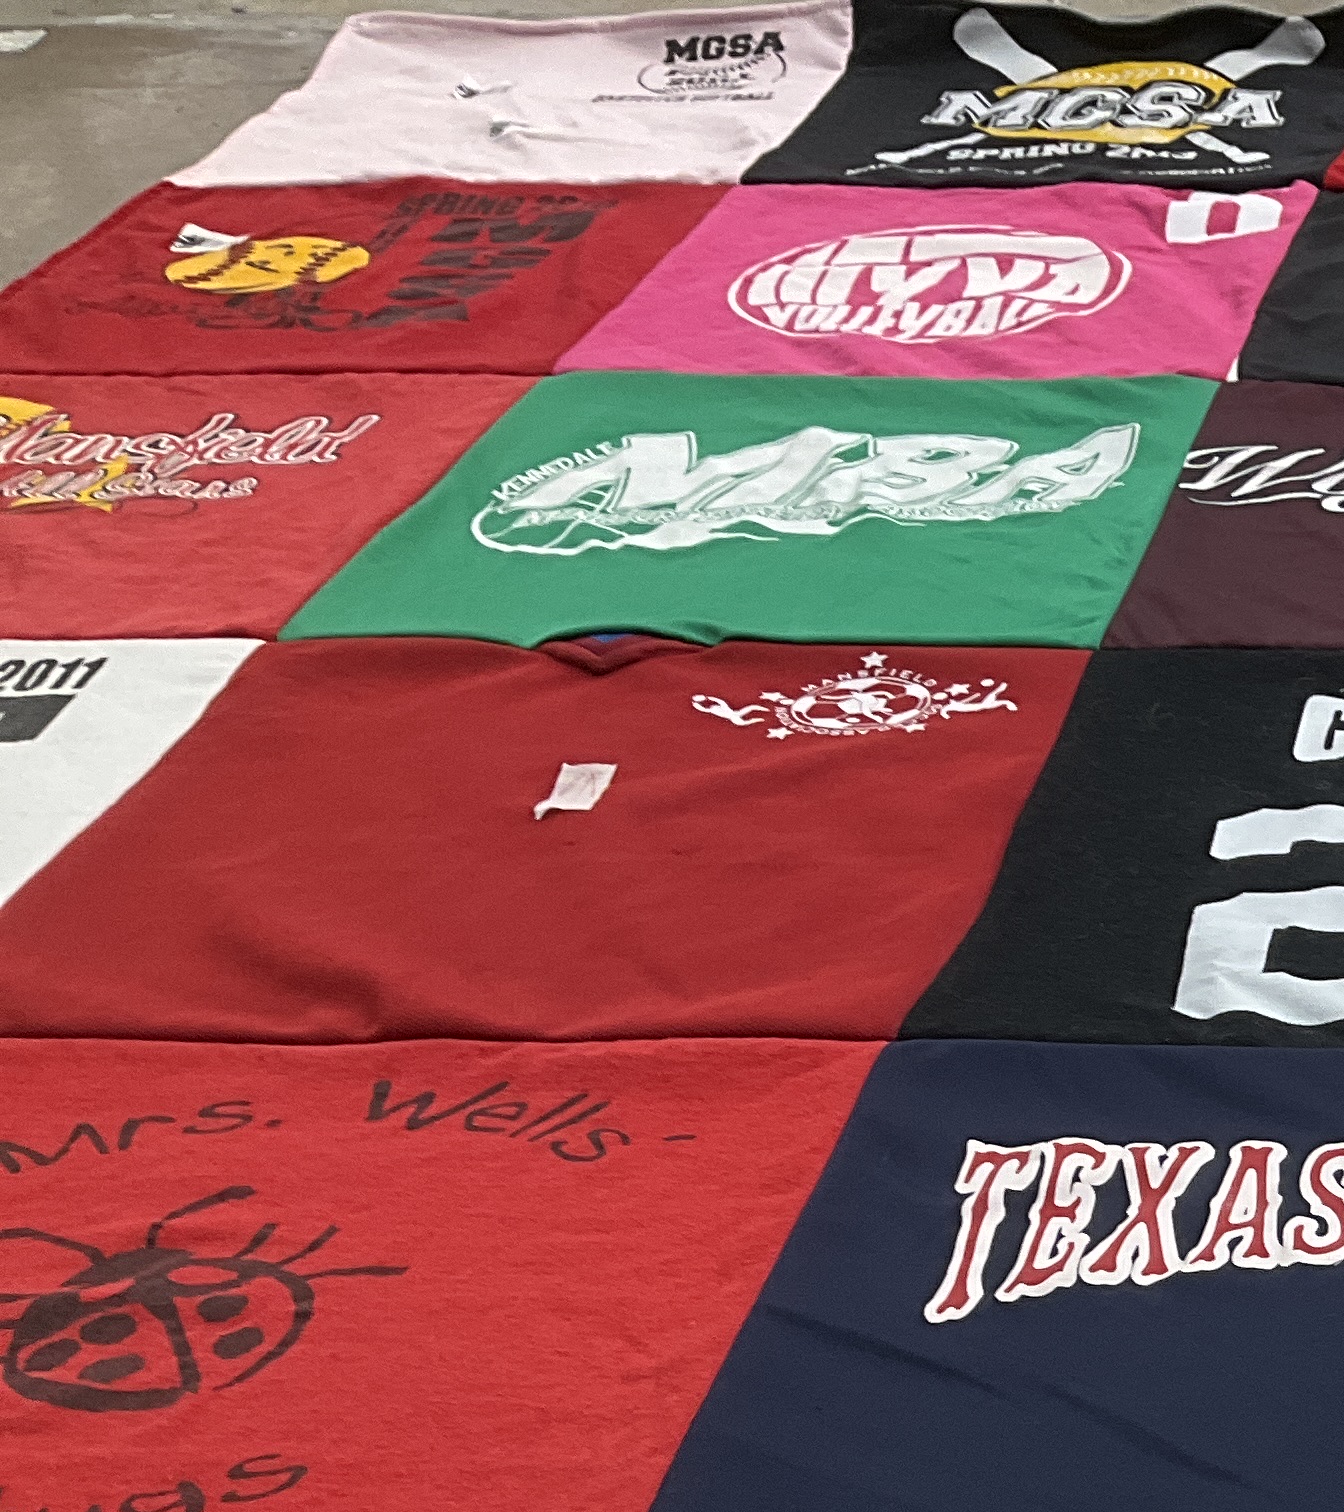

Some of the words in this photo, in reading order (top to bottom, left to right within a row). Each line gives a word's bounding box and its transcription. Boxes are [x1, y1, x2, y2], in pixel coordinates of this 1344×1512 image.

[662, 31, 786, 64] MGSA
[760, 296, 1052, 340] VOLLEYBALL
[0, 657, 108, 691] 2011
